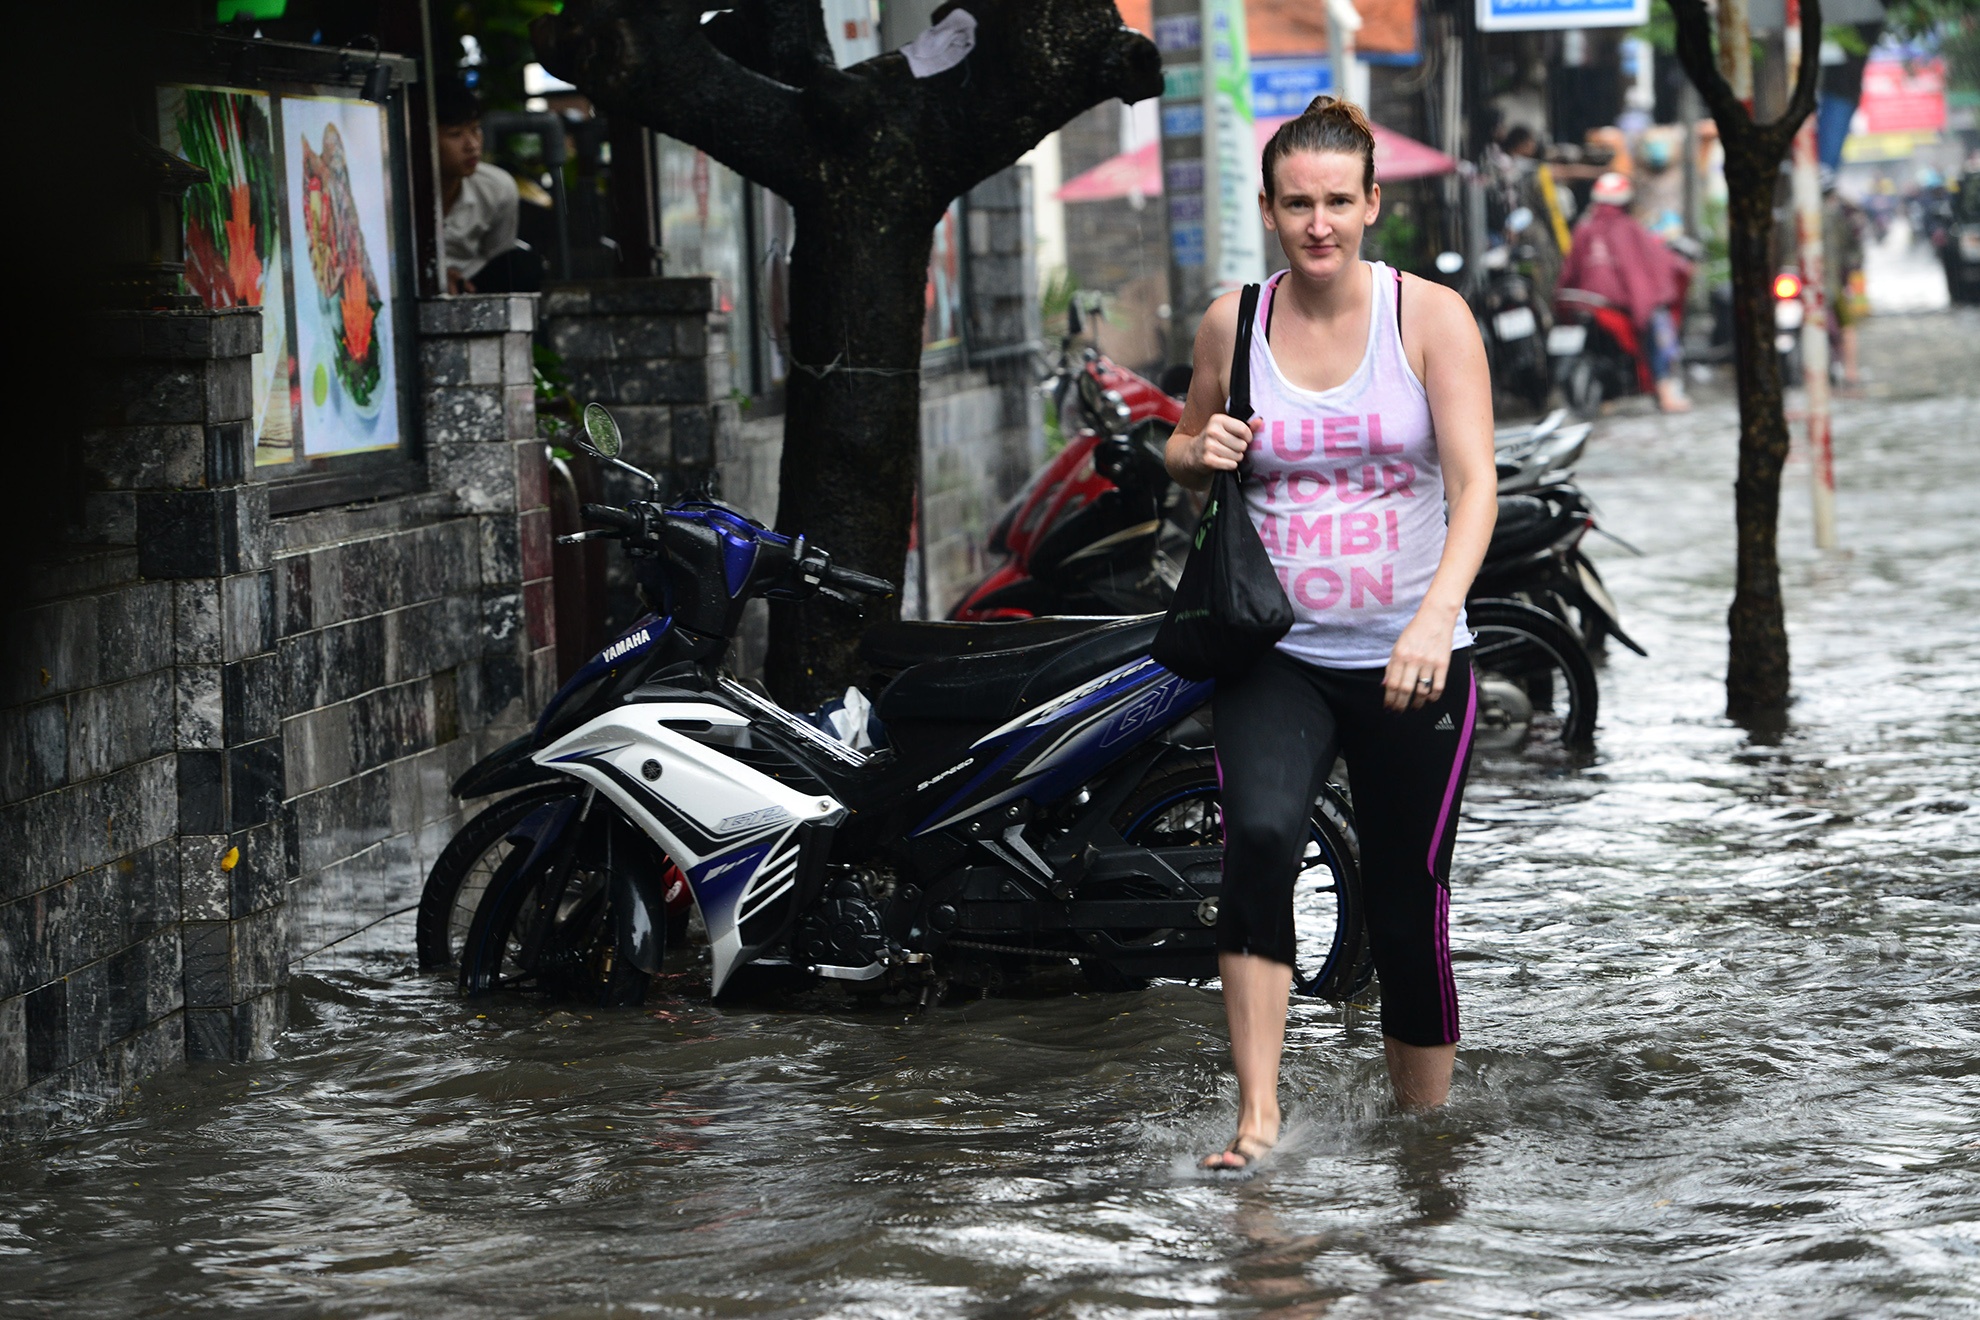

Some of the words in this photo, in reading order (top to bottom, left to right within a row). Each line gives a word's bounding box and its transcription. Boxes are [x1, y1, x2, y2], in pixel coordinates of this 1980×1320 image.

[1253, 461, 1416, 505] YOUR
[1259, 510, 1400, 557] AMBI
[602, 629, 651, 663] YAMAHA
